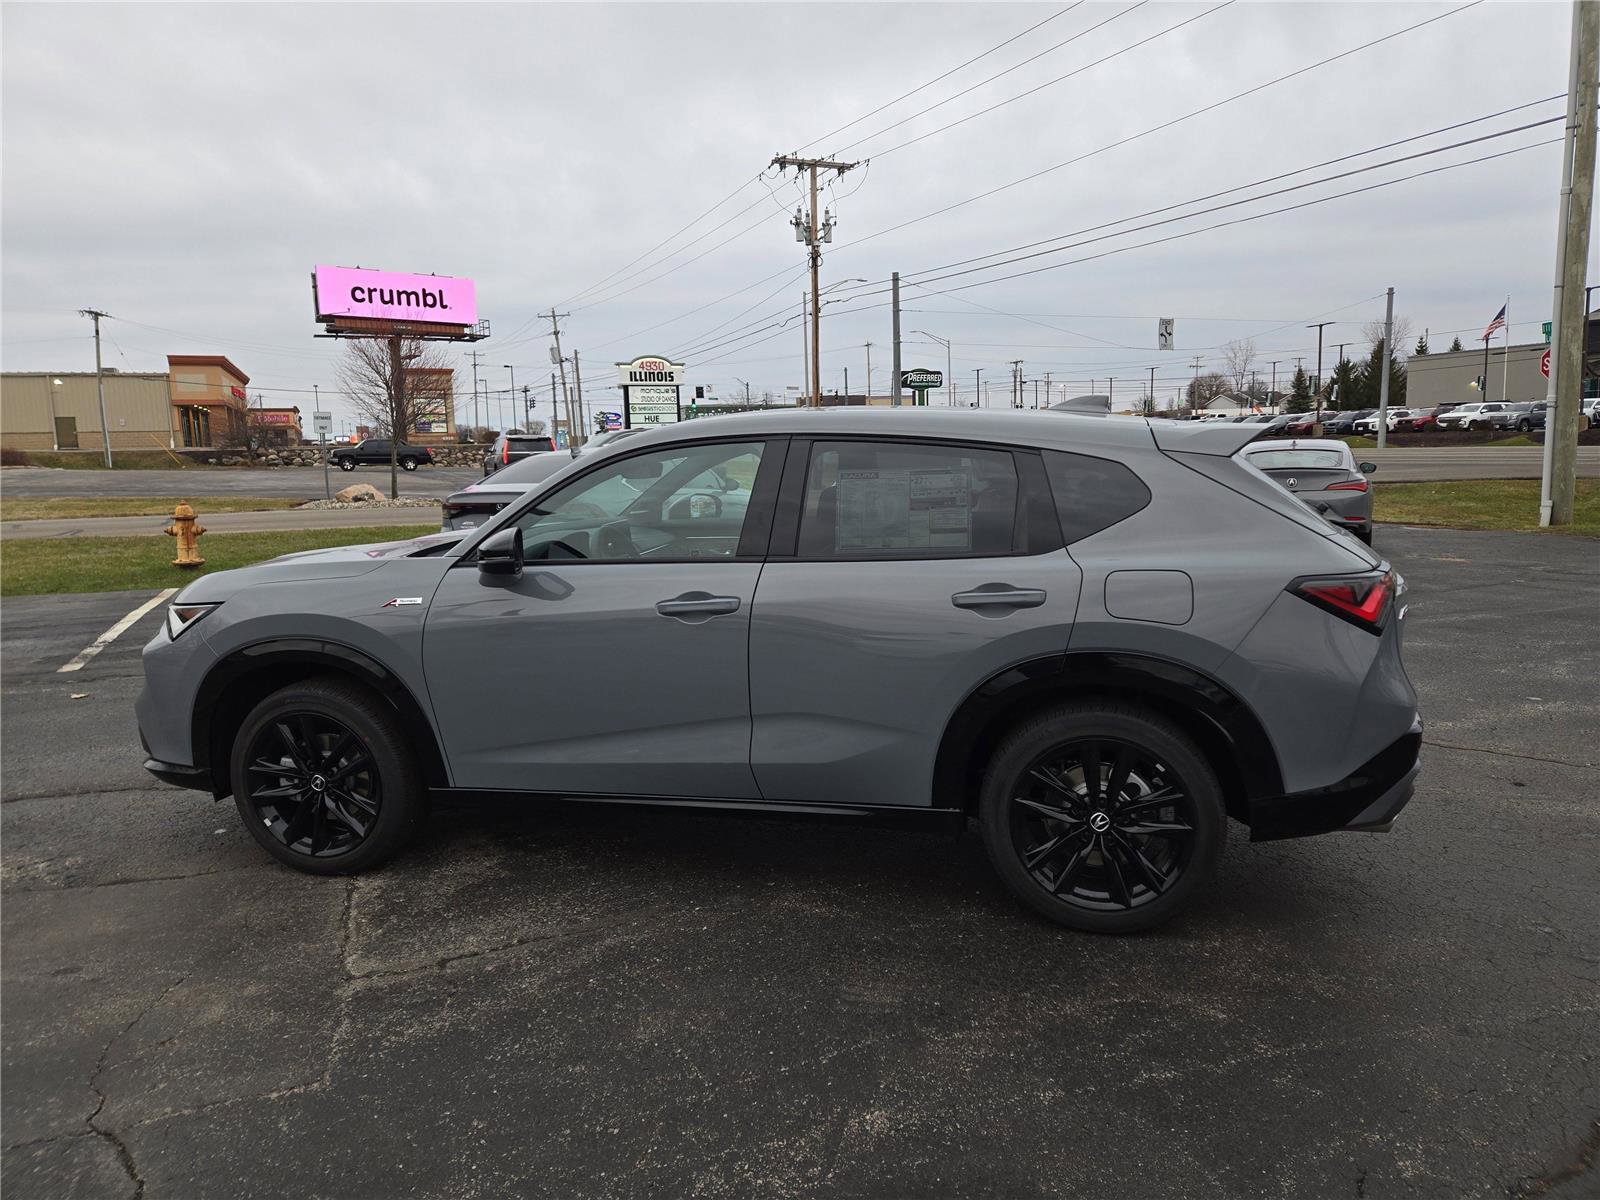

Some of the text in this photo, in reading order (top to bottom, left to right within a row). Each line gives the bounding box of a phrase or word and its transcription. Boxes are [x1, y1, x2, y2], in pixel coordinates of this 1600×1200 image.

[351, 286, 449, 310] crumbl
[639, 361, 665, 371] 4930
[629, 371, 675, 382] ILLINOIS
[644, 415, 660, 423] HUE
